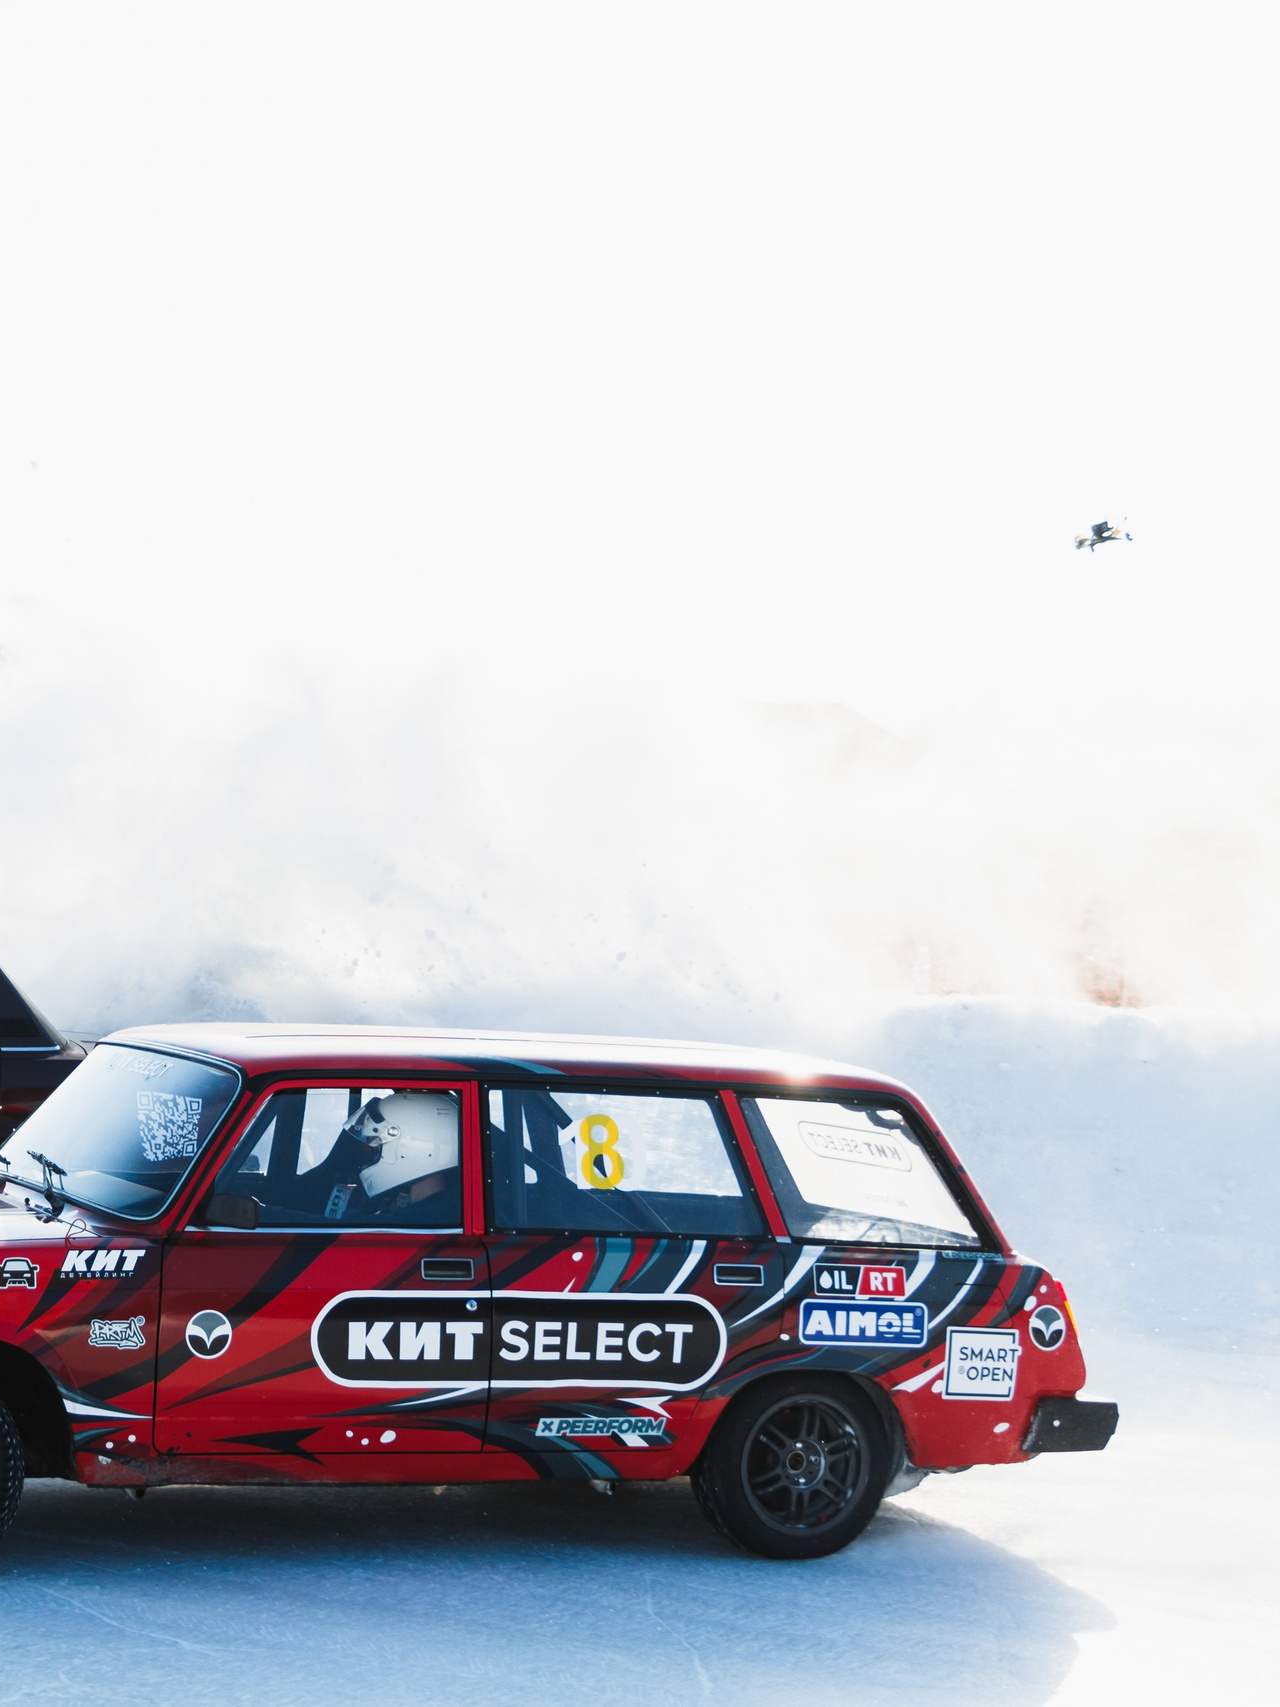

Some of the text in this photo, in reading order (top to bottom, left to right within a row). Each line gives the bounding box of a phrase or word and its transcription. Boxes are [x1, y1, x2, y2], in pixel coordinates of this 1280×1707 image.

[580, 1114, 624, 1189] 8
[61, 1249, 146, 1271] КИТ
[869, 1271, 897, 1291] RT
[347, 1320, 693, 1363] КИТ SELECT
[959, 1346, 1019, 1363] SMART
[966, 1366, 1013, 1381] OPEN
[556, 1418, 665, 1434] PEERFORM
